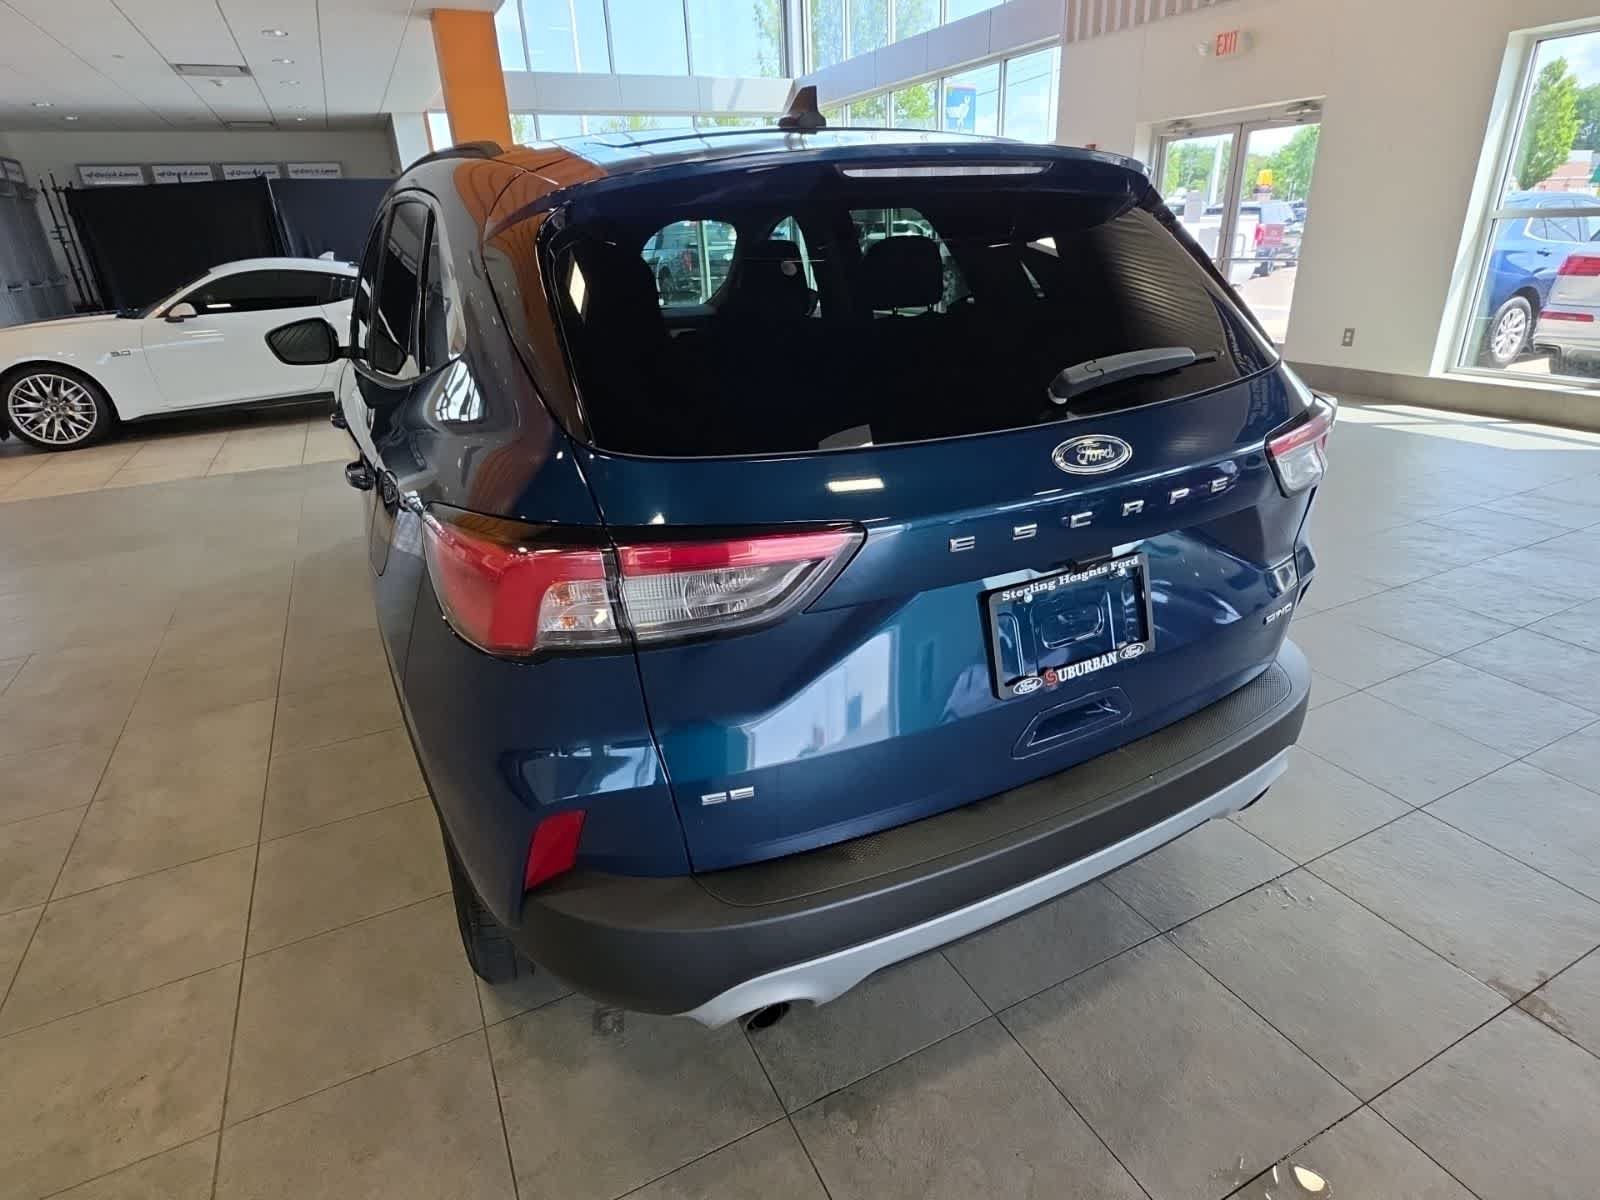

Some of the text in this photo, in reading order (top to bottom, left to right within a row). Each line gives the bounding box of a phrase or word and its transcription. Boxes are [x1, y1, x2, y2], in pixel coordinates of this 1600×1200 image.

[1216, 30, 1239, 57] EXIT
[949, 476, 1229, 552] ESCAPE
[1002, 555, 1139, 601] Sterling Heights Ford
[1044, 651, 1119, 687] SUBURBAN
[701, 786, 754, 806] SE
